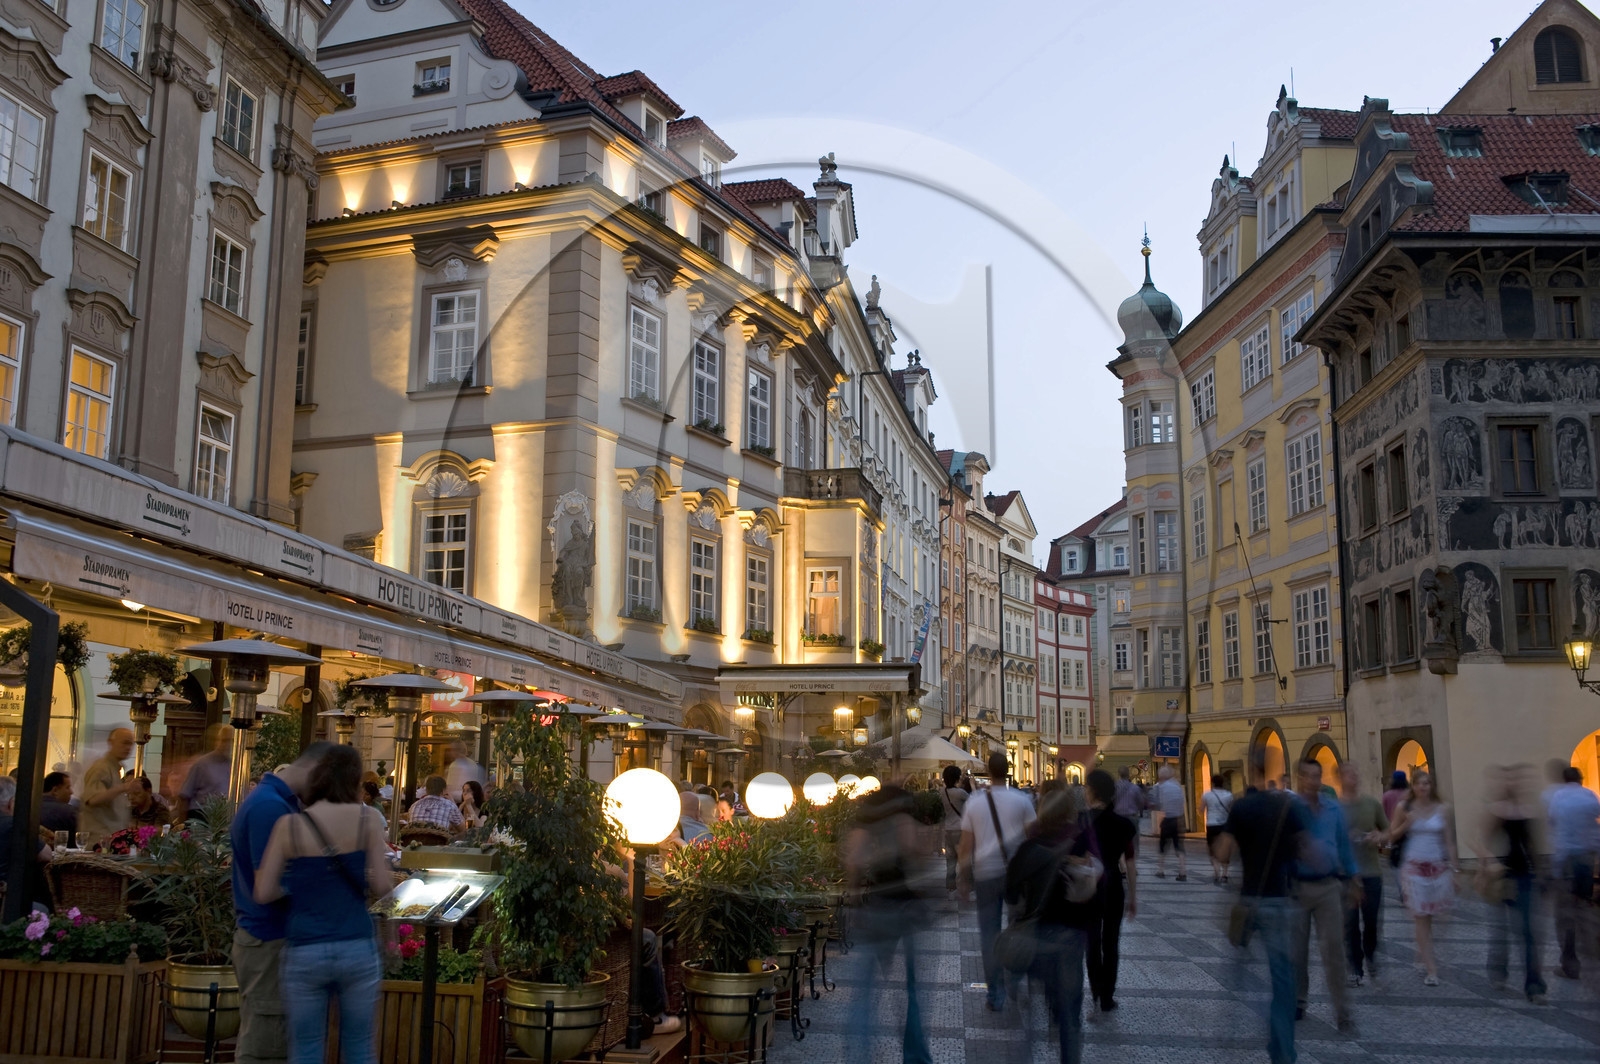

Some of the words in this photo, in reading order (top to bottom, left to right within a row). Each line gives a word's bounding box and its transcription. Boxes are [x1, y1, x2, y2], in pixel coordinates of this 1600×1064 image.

[146, 493, 190, 521] STAROPRAMEN
[283, 541, 314, 563] STAROPRAMEN
[83, 555, 130, 581] STAROPRAMEN
[378, 577, 415, 609] HOTEL
[418, 591, 426, 612] U
[428, 595, 463, 624] PRINCE
[227, 601, 254, 620] HOTEL
[257, 609, 263, 622] U
[265, 611, 293, 629] PRINCE
[434, 652, 450, 664] HOTEL
[455, 655, 472, 668] PRINCE
[586, 650, 601, 668] HOTEL
[607, 658, 623, 675] PRINCE
